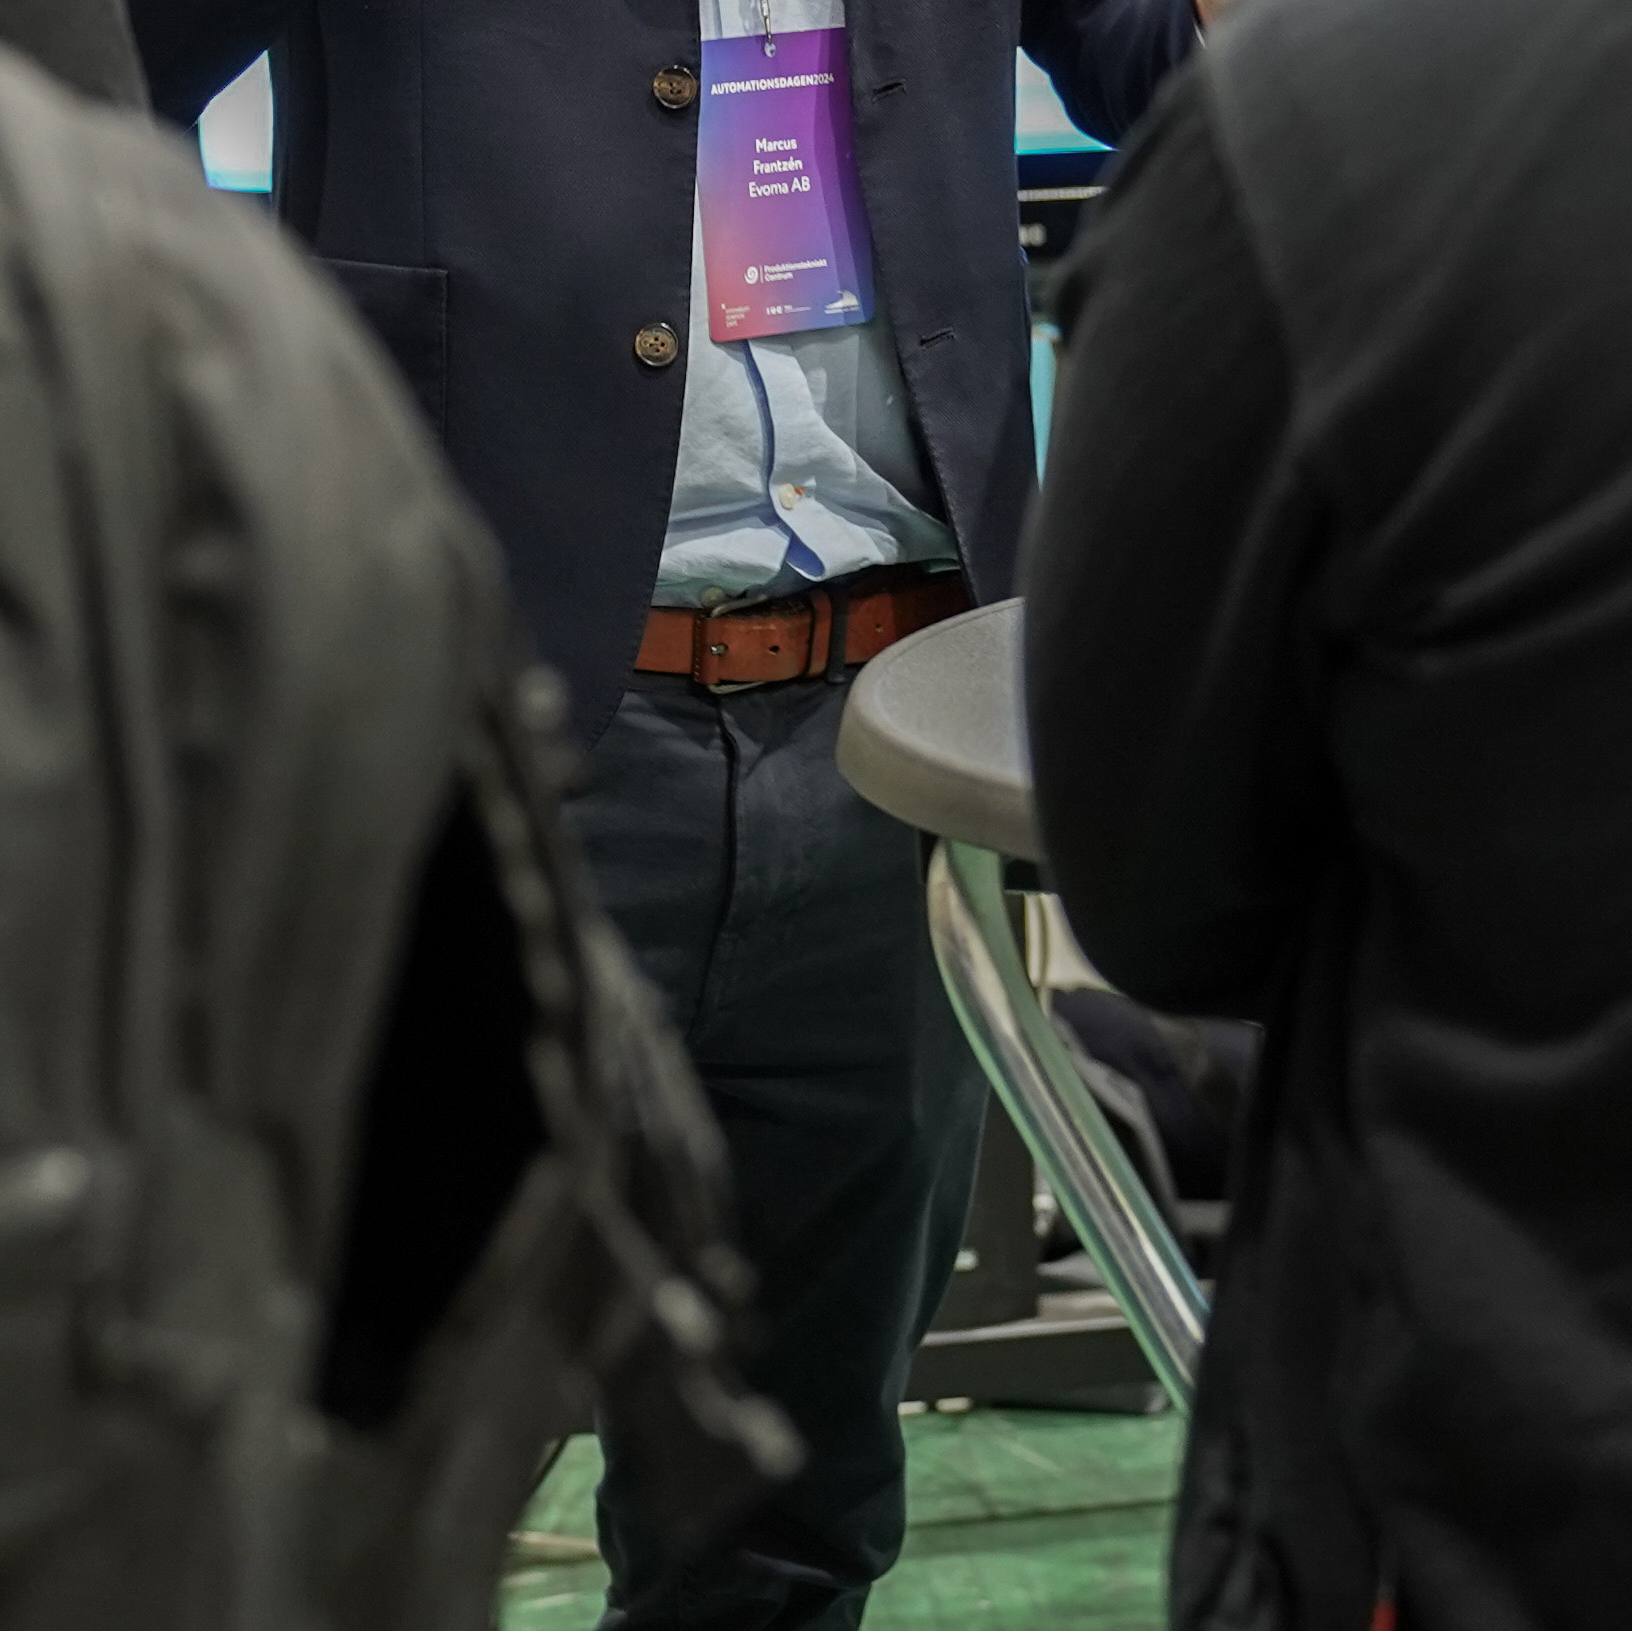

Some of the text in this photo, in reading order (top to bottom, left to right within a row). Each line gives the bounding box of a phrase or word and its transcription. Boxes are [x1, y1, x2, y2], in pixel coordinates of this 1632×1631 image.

[755, 138, 797, 153] Marcus
[753, 156, 803, 175] Frantzén
[749, 176, 811, 197] Evoma AB
